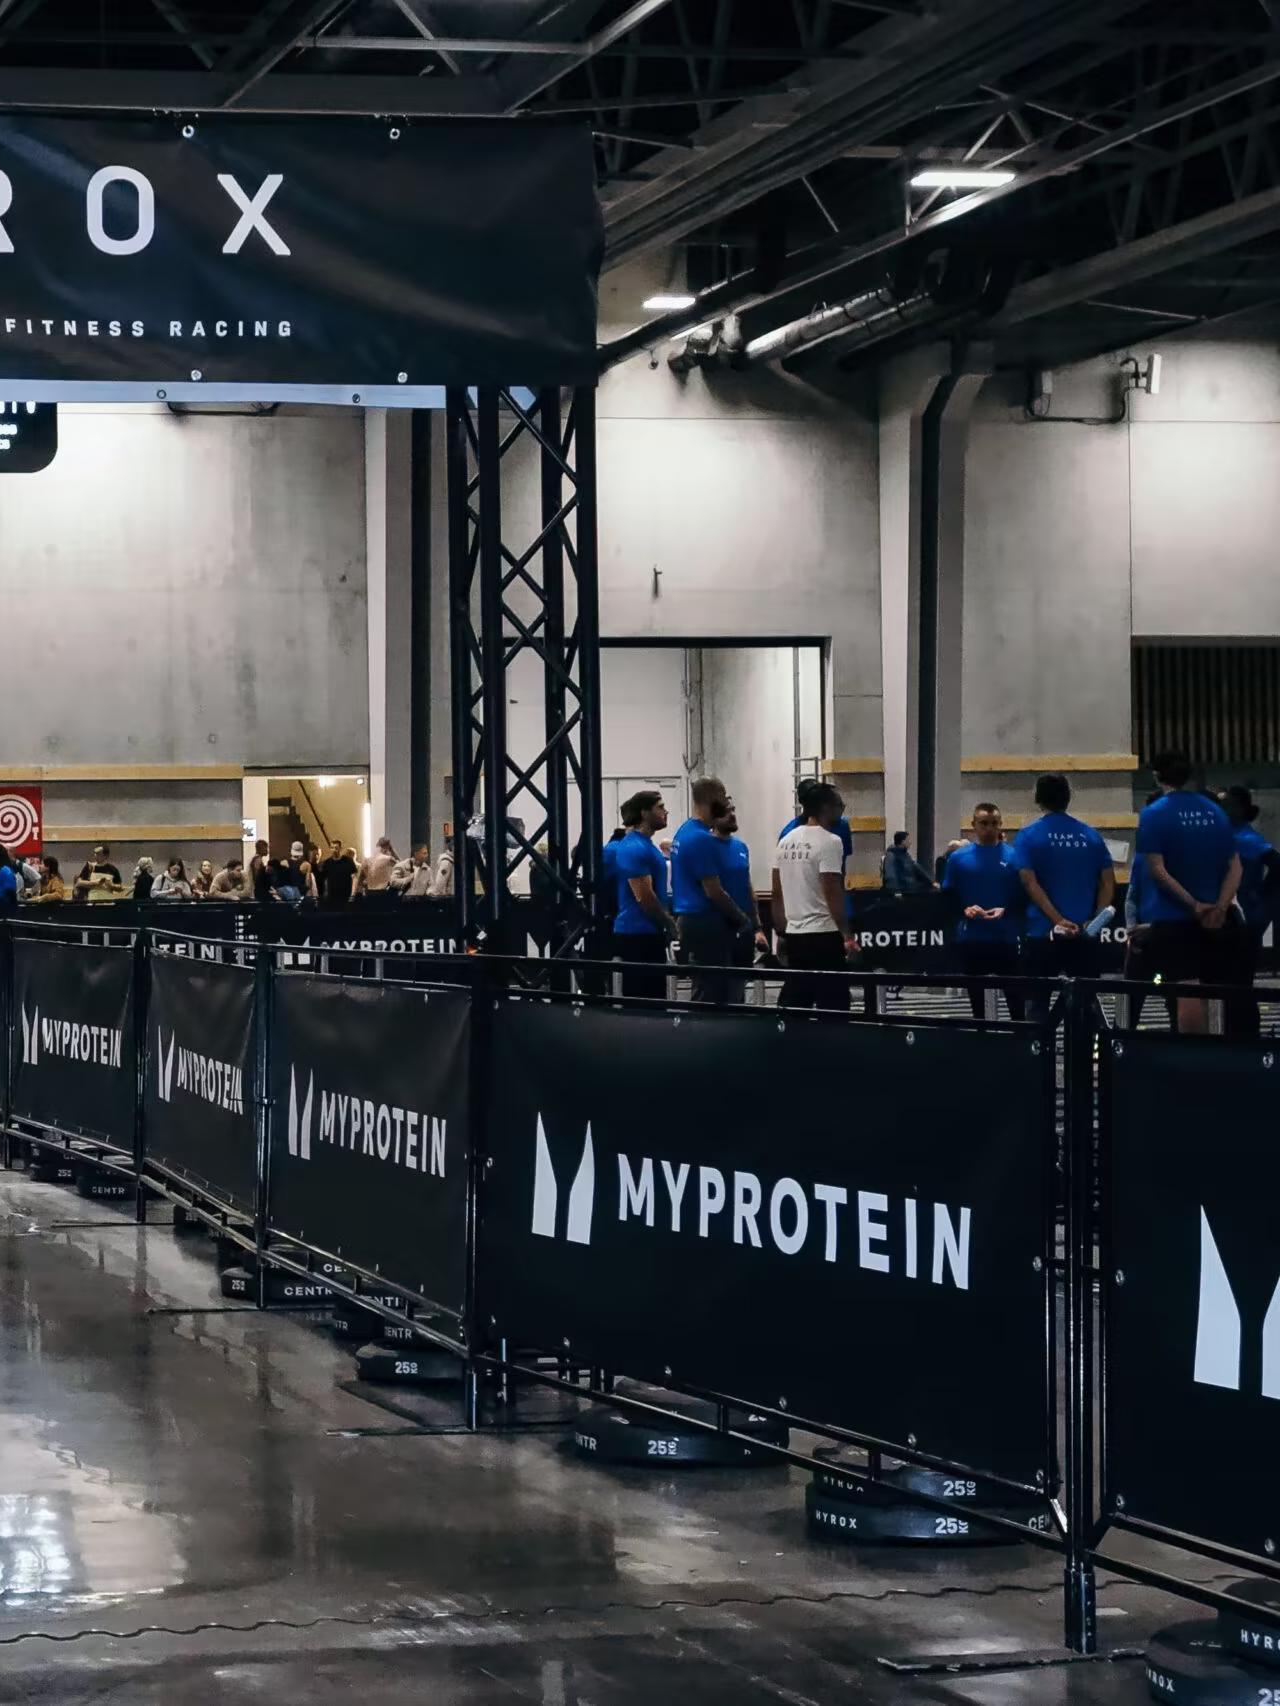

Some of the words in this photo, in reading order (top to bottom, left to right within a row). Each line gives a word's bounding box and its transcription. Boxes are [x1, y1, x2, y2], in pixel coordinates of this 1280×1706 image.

[5, 318, 145, 337] FITNESS
[169, 320, 293, 337] RACING
[42, 1017, 121, 1069] MYPROTEIN
[177, 1045, 243, 1115] MYPROTEIN
[319, 1089, 447, 1178] MYPROTEIN
[617, 1152, 972, 1291] MYPROTEIN
[815, 1509, 857, 1529] HYROX
